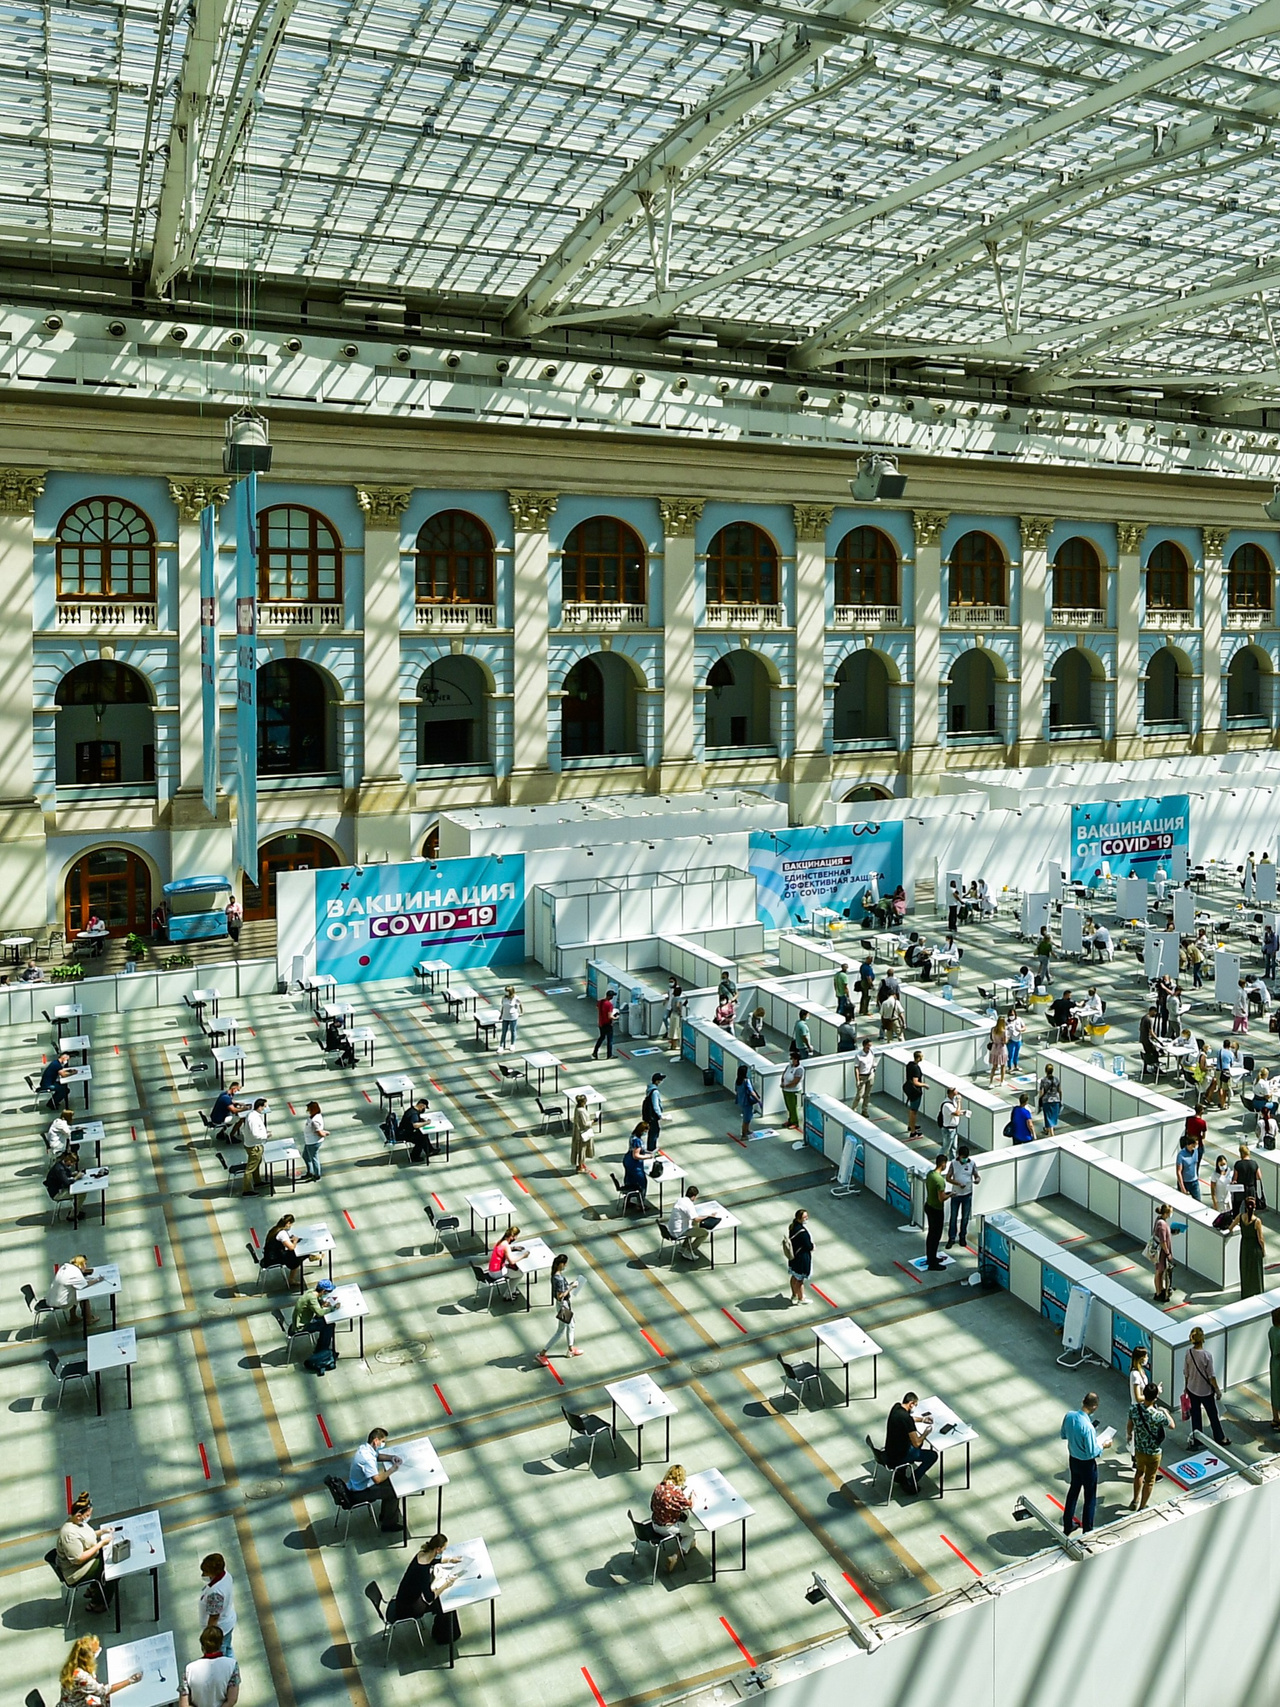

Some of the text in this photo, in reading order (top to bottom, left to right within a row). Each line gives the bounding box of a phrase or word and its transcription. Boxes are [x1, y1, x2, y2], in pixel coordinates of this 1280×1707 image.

[1077, 816, 1184, 840] ВАКЦИНАЦИЯ
[1077, 834, 1172, 857] ОТ COVID-19
[784, 858, 843, 870] ВАКЦИНАЦИЯ
[784, 868, 850, 882] ЕДИНСТВЕННАЯ
[784, 873, 884, 890] ЭФФЕКТИВНАЯ ЗАЩА
[326, 882, 515, 918] ВАКЦИНАЦИЯ
[800, 886, 838, 896] COVID-19
[326, 908, 494, 941] ОТ COVID-19
